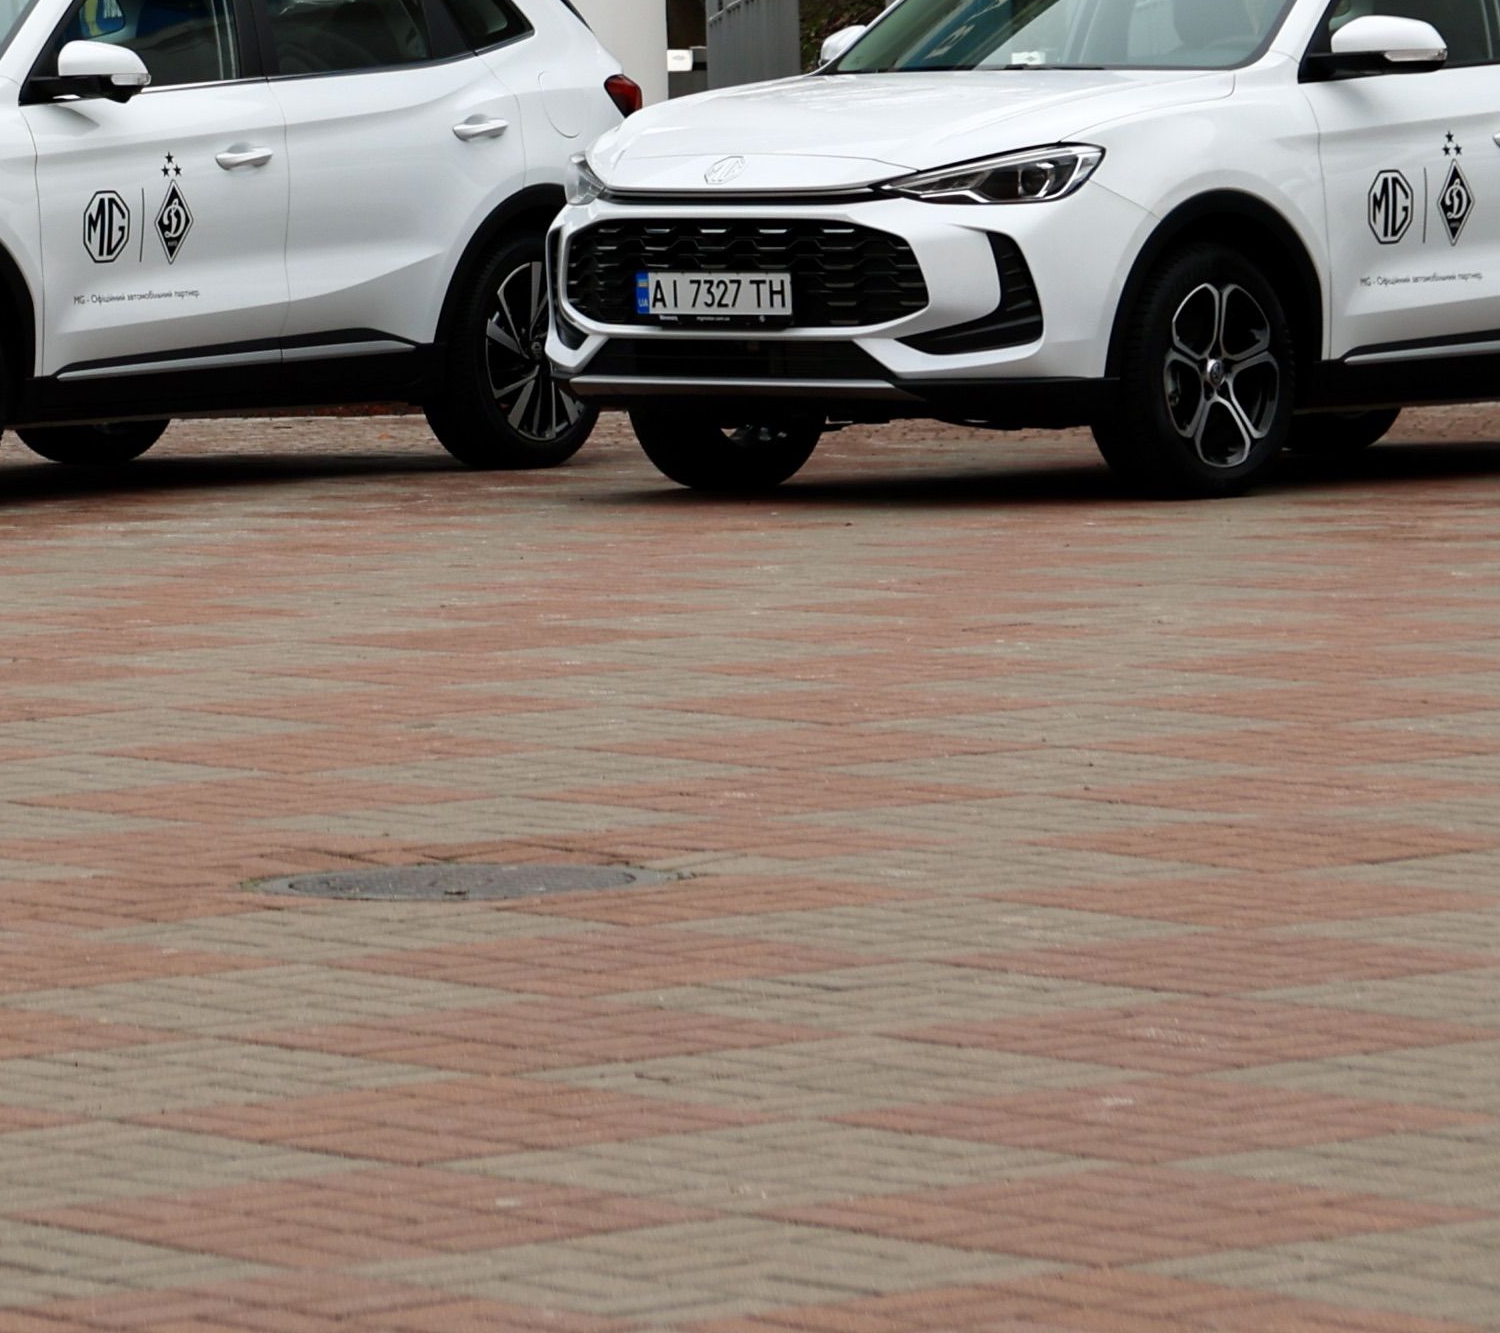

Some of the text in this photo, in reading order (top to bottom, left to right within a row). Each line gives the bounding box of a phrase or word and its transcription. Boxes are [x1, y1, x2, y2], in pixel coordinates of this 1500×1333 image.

[88, 198, 126, 256] MG
[1373, 176, 1409, 237] MG
[73, 295, 85, 304] MG
[652, 279, 786, 308] AI 7327 TH
